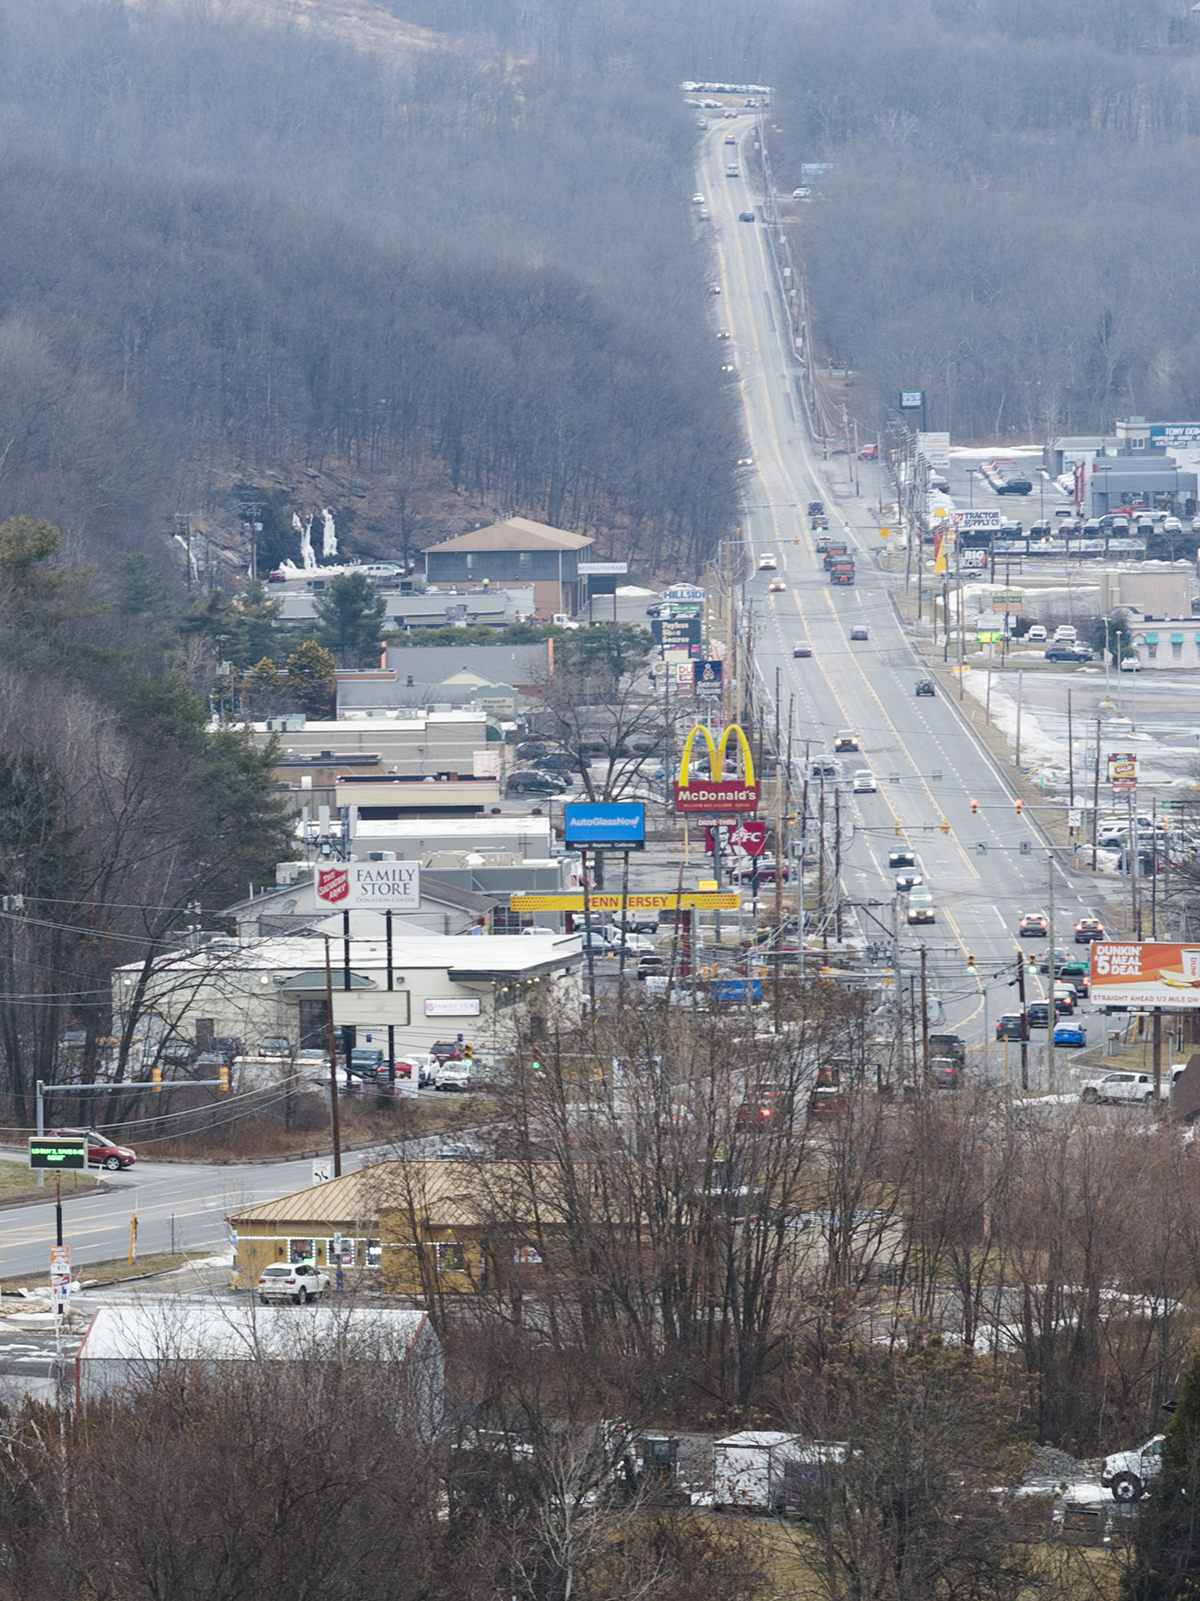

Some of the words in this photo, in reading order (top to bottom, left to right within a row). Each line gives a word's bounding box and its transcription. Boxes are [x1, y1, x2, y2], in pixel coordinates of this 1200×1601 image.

[965, 550, 985, 559] BIG
[964, 560, 982, 568] LOTS
[662, 622, 689, 630] Payless
[678, 790, 757, 800] McDonald's
[322, 871, 336, 883] THE
[356, 870, 416, 882] FAMILY
[328, 884, 346, 900] ARMY
[361, 883, 411, 896] STORE
[588, 896, 619, 908] ENN
[628, 896, 668, 907] ERSEY
[1096, 946, 1142, 956] DUNKIN'
[1111, 956, 1142, 966] MEAL
[1111, 966, 1142, 976] DEAL
